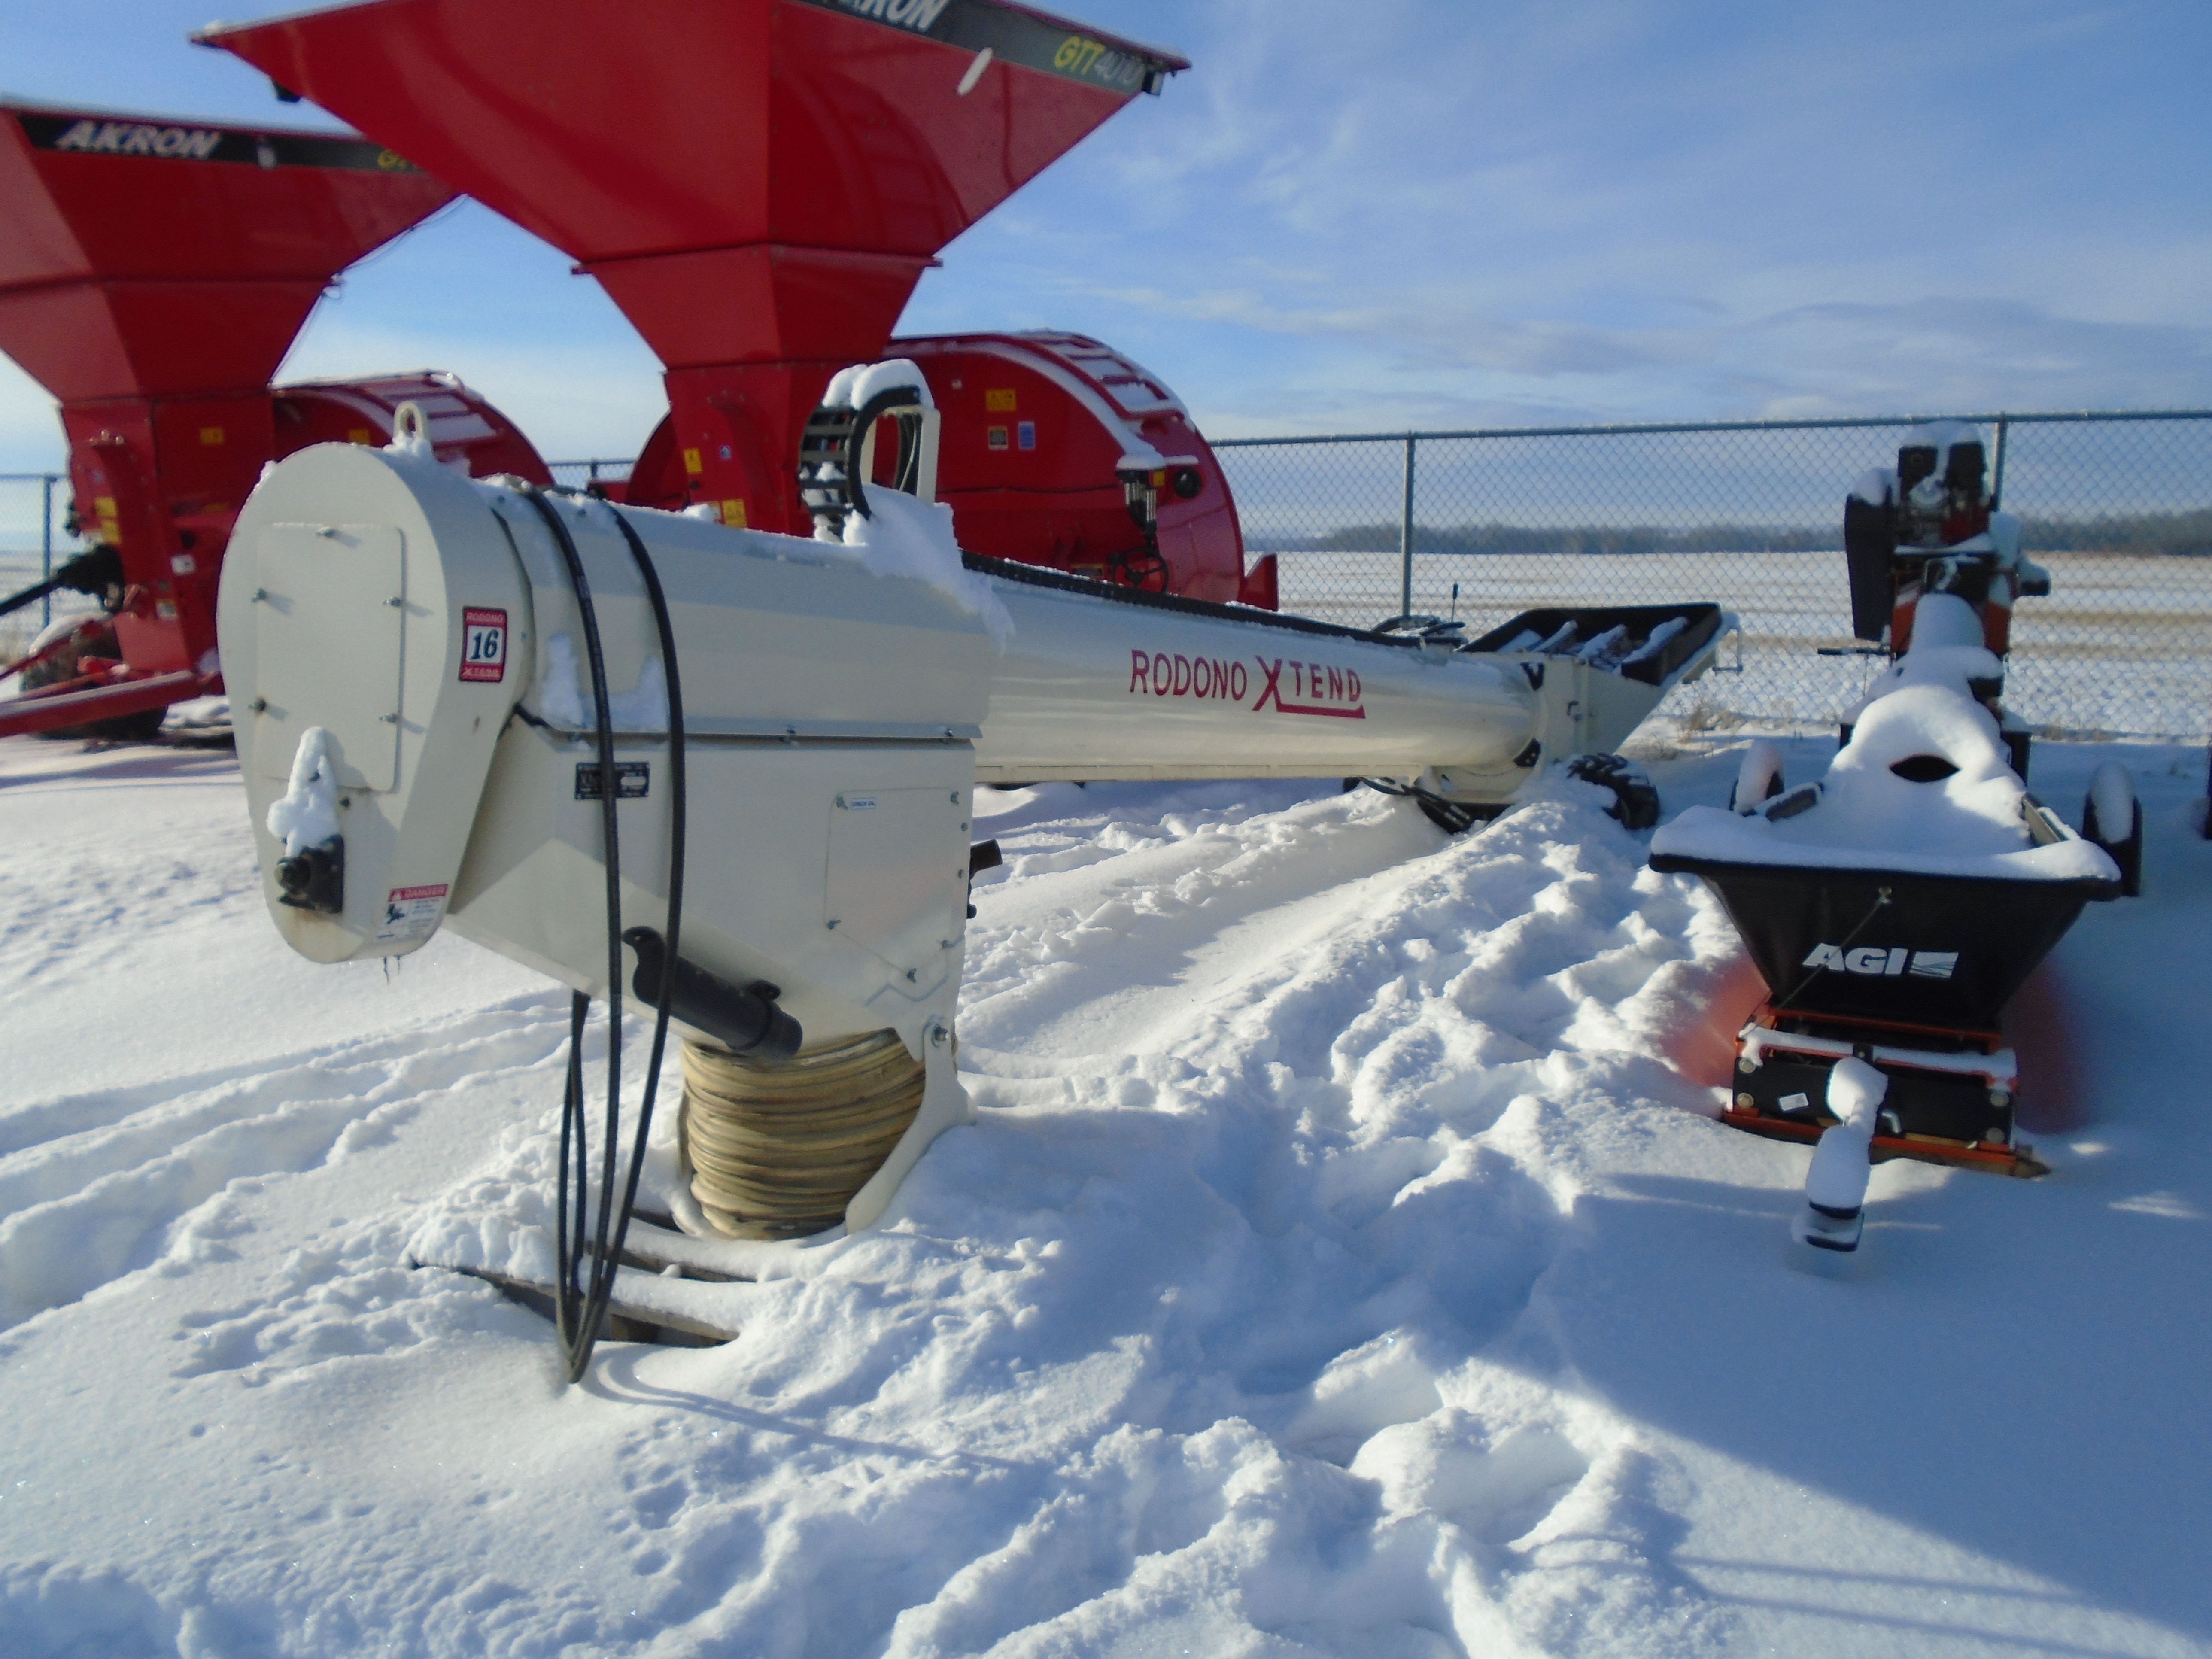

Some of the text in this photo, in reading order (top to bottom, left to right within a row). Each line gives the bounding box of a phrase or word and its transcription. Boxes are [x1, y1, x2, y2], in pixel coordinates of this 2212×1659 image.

[55, 120, 222, 160] AKRON
[466, 612, 504, 623] RODONO
[470, 629, 499, 659] 16
[1129, 649, 1366, 719] RODONO XTEND
[404, 886, 445, 898] DANGER
[1802, 942, 1908, 975] AGI
